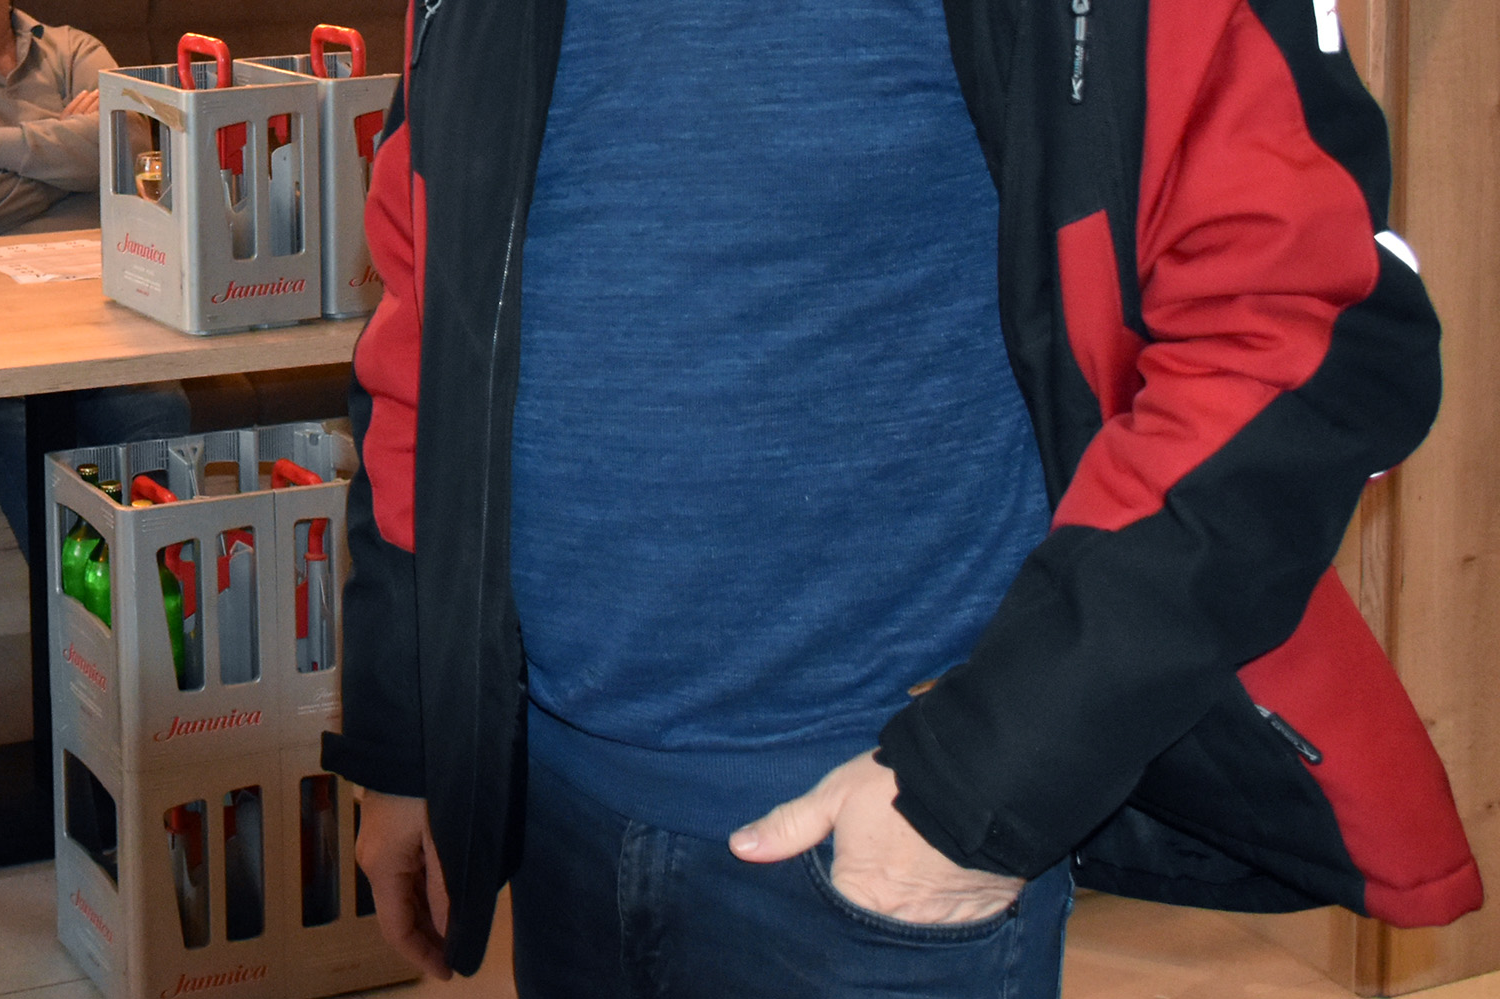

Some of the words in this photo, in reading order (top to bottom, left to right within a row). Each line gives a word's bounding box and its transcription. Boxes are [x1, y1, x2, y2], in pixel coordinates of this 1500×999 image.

[116, 232, 167, 266] Jamnica
[211, 277, 306, 304] Jamnica
[153, 709, 263, 742] Jamnica
[160, 964, 268, 999] Jamnica
